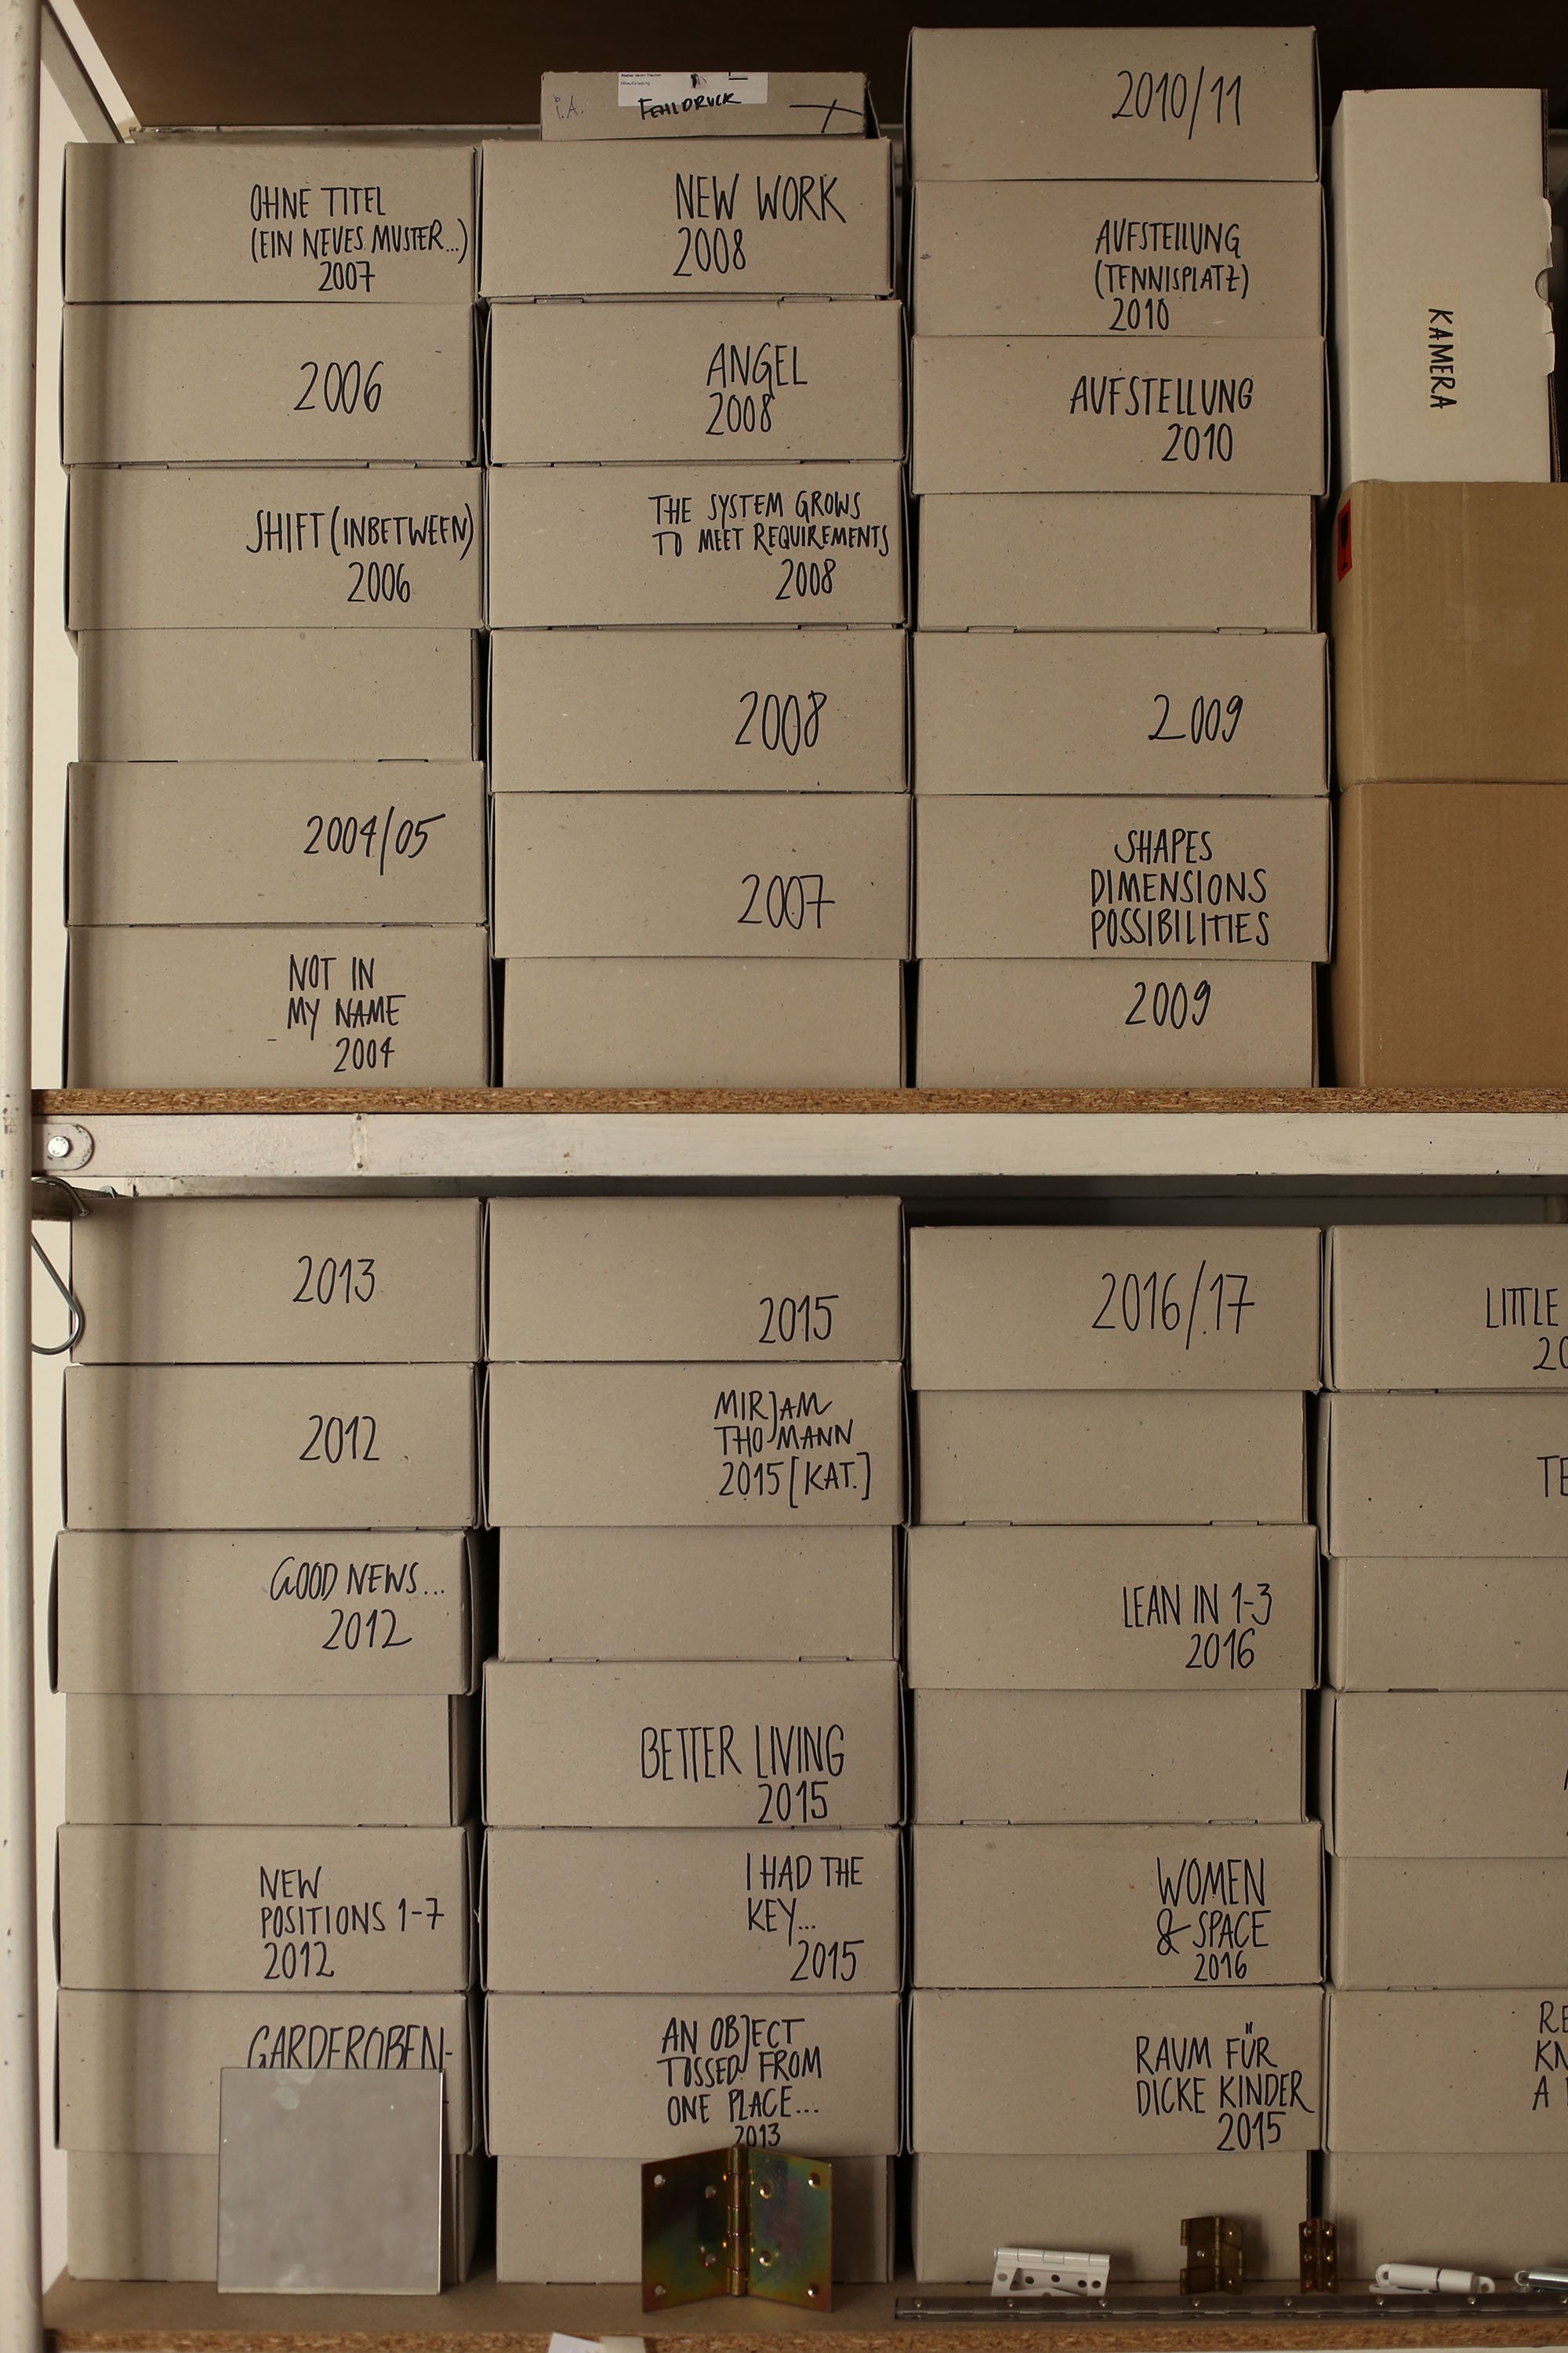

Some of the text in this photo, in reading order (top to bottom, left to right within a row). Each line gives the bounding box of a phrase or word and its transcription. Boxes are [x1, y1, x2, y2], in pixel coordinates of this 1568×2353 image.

[1111, 65, 1242, 140] 2010/11
[250, 183, 387, 221] OHNE TITEL
[675, 172, 847, 224] NEW WORK
[251, 227, 293, 263] (EIN
[303, 225, 364, 260] NEUES
[672, 227, 746, 278] 2008
[1094, 217, 1242, 259] AUFSTELLUNG
[318, 260, 376, 293] 2007
[1094, 259, 1249, 300] (TENNISPLATZ)
[1108, 297, 1170, 332] 2010
[706, 342, 808, 399] ANGEL
[1428, 308, 1457, 409] KAMERA
[292, 359, 384, 415] 2006
[1069, 375, 1254, 416] AUFSTELLUNG
[705, 390, 774, 436] 2008
[1160, 423, 1233, 462] 2010
[245, 503, 474, 561] SHIFT (INBETWEEN)
[648, 490, 861, 532] THE SYSTEM GROWS
[652, 522, 889, 557] TO MEET REQUIREMENTS
[347, 561, 411, 603] 2006
[775, 557, 837, 601] 2008
[734, 689, 828, 757] 2008
[1147, 694, 1243, 745] 2009
[303, 805, 447, 877] 2004/05
[1113, 828, 1213, 866] SHAPES
[737, 873, 836, 930] 2007
[1091, 868, 1267, 908] DIMENSIONS
[1091, 907, 1269, 950] POSSIBILITIES
[289, 953, 375, 992] NOT IN
[286, 994, 407, 1041] MY NAME
[1124, 979, 1211, 1030] 2009
[332, 1036, 396, 1073] 2004
[292, 1255, 376, 1305] 2013
[758, 1295, 840, 1344] 2015
[1091, 1259, 1255, 1350] 2016/17
[1486, 1287, 1559, 1329] LITTLE
[713, 1389, 833, 1445] MIRJAM
[299, 1414, 380, 1464] 2012
[713, 1418, 854, 1460] THOMANN
[718, 1461, 785, 1497] 2015
[270, 1556, 339, 1602] GOOD
[1123, 1581, 1272, 1629] LEAN IN 1-3
[321, 1608, 413, 1650] 2012
[1185, 1629, 1256, 1670] 2016
[641, 1724, 845, 1784] BETTER LIVING
[757, 1780, 829, 1825] 2015
[260, 1865, 322, 1901] NEW
[746, 1852, 865, 1892] I HAD THE
[1156, 1856, 1265, 1908] WOMEN
[260, 1897, 445, 1939] POSITIONS 1-7
[747, 1897, 819, 1948] KEY...
[1156, 1908, 1272, 1956] & SPACE
[263, 1941, 335, 1980] 2012
[788, 1937, 865, 1982] 2015
[1193, 1952, 1247, 1982] 2016
[661, 2013, 808, 2075] AN OBJECT
[1135, 2021, 1279, 2075] RAUM FÜR
[656, 2046, 822, 2089] TOSSED FROM
[667, 2085, 819, 2126] ONE PLACE...
[1136, 2069, 1316, 2117] DICKE KINDER
[1532, 2075, 1549, 2112] A
[734, 2123, 781, 2148] 2013
[1216, 2111, 1287, 2151] 2015
